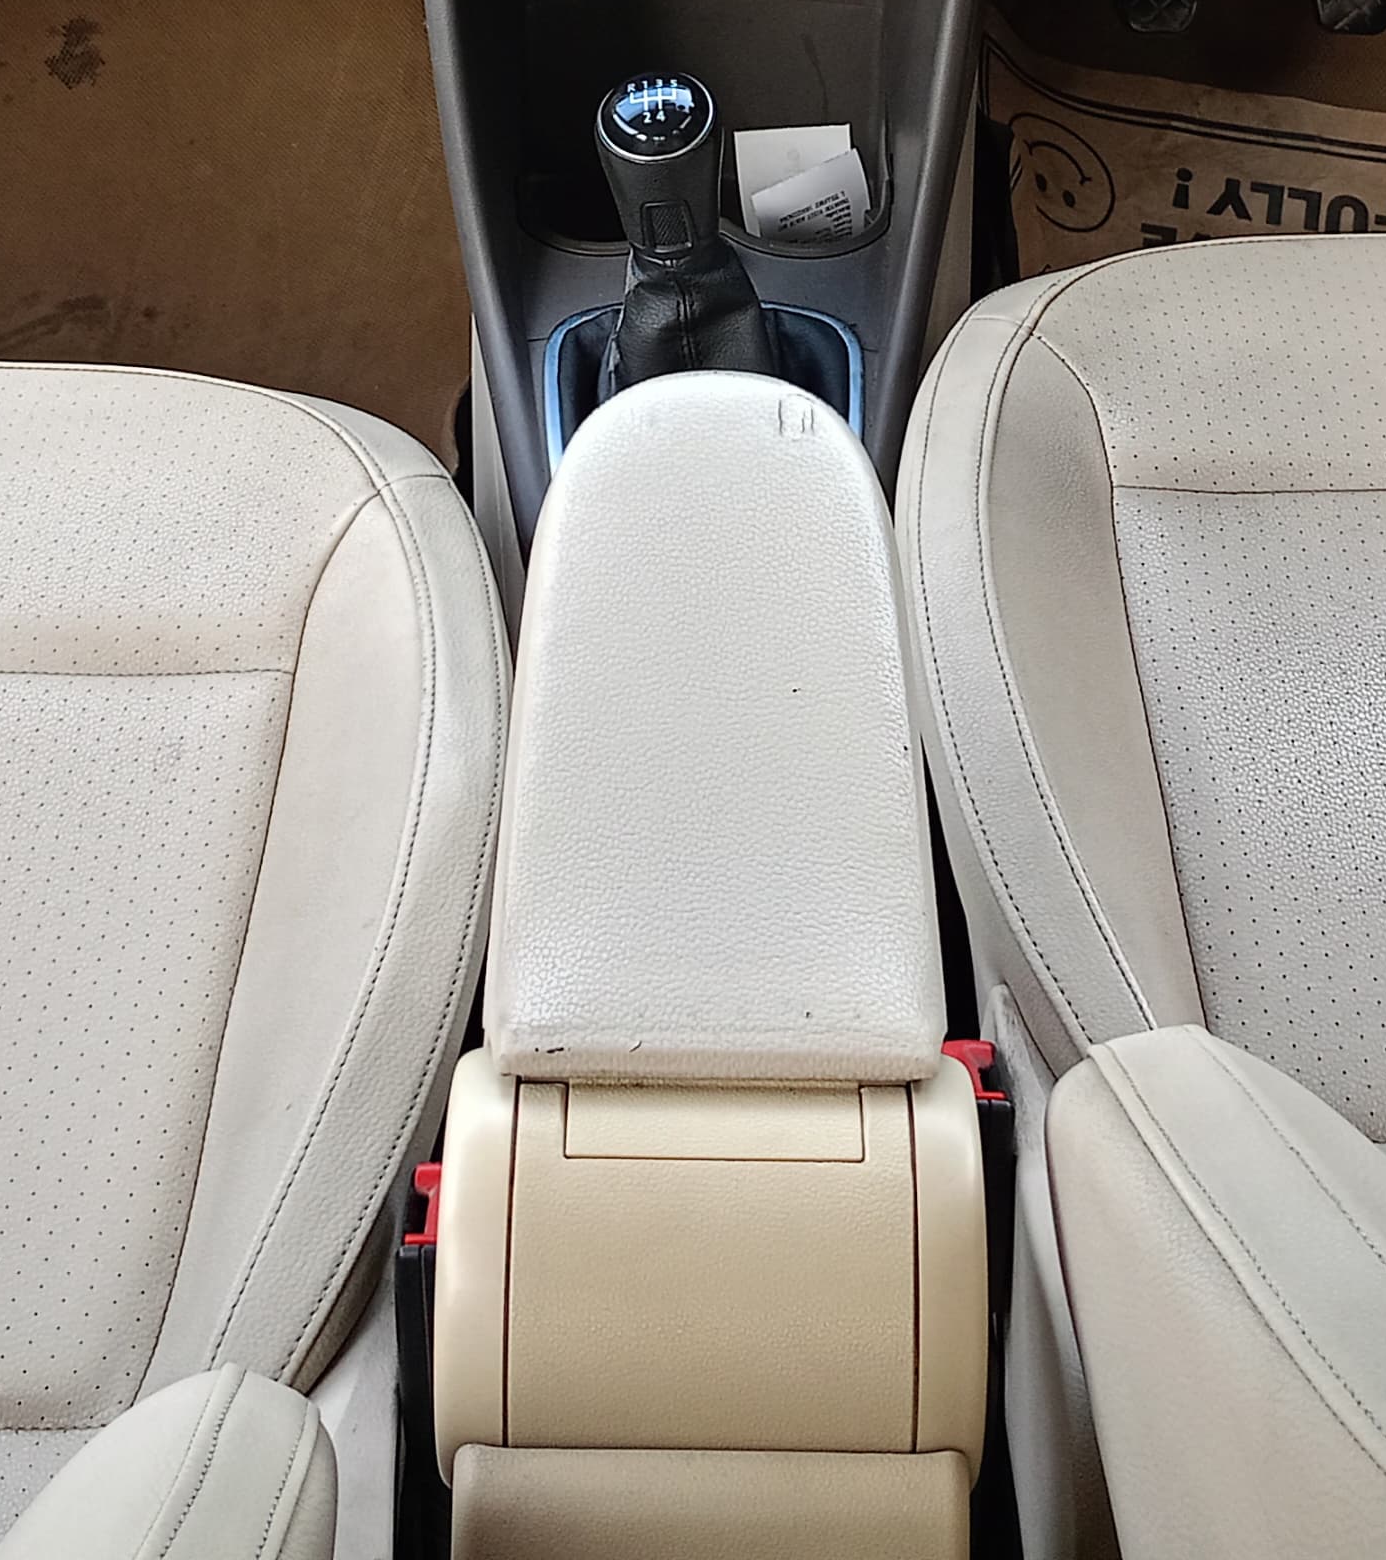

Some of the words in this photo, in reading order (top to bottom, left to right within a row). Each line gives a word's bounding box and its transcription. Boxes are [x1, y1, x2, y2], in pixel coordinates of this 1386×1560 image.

[642, 80, 649, 89] 1
[655, 78, 663, 88] 3
[670, 79, 678, 88] 5
[643, 112, 652, 124] 2
[656, 110, 666, 122] 4
